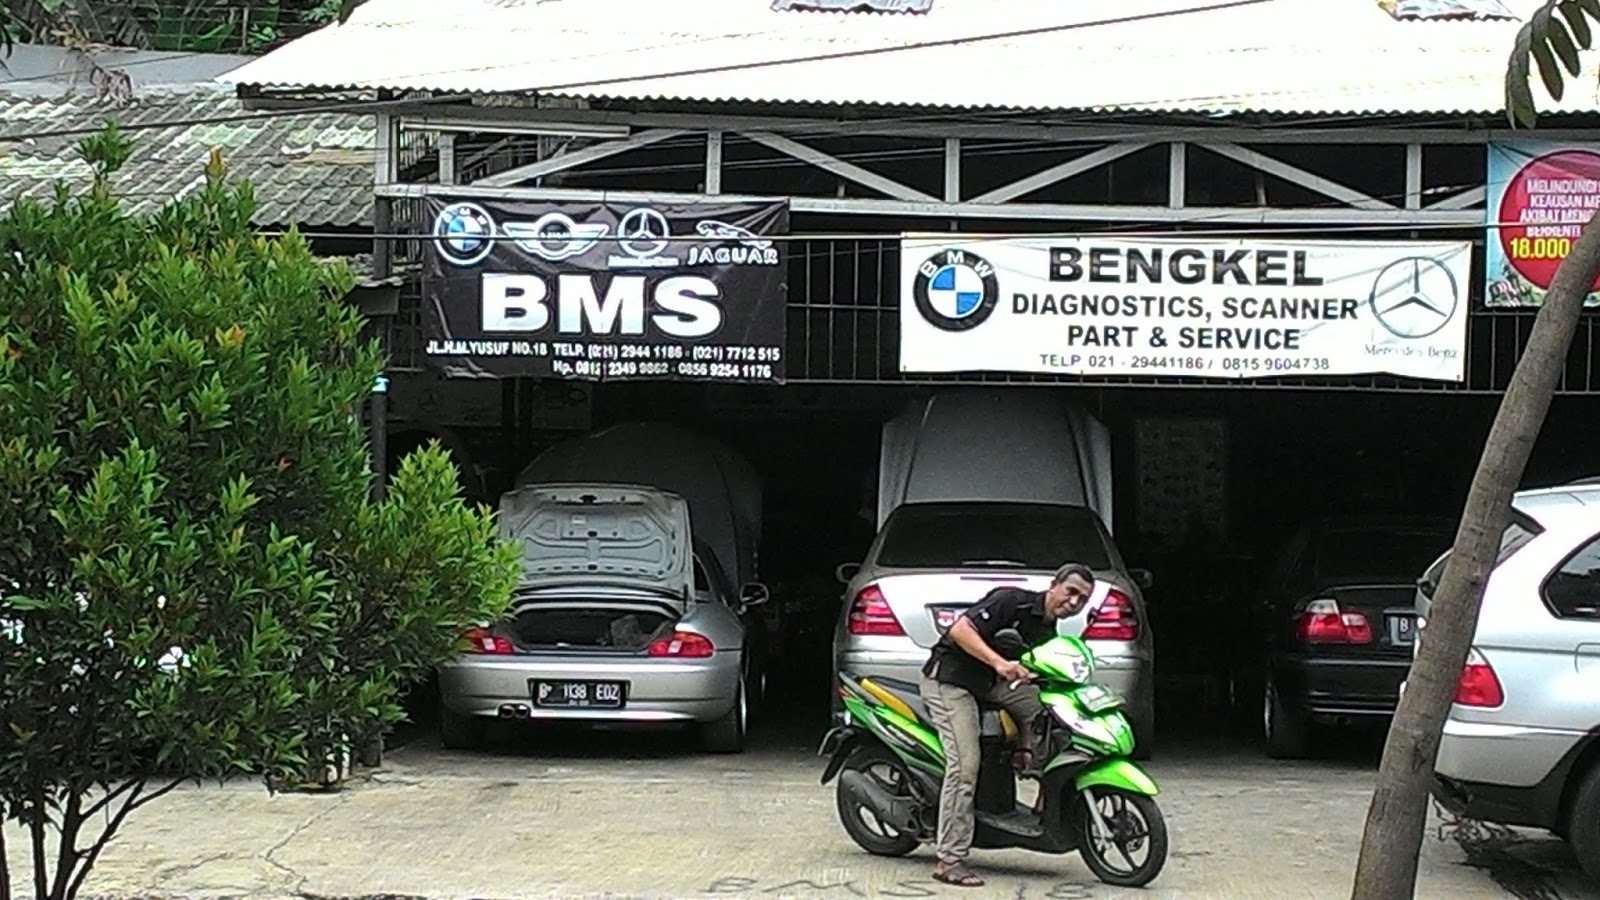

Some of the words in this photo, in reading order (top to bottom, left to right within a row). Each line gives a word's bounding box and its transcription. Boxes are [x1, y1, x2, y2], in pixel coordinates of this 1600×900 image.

[1530, 194, 1582, 208] KEAUSAN
[1520, 208, 1559, 224] AKIBAT
[687, 247, 778, 265] JAGUAR
[920, 250, 993, 278] BMW
[1048, 247, 1324, 286] BENGKEL
[481, 273, 722, 337] BMS
[1012, 293, 1212, 323] DIAGNOSTICS,
[1221, 298, 1358, 320] SCANNER
[1067, 325, 1139, 347] PART
[1149, 327, 1168, 348] &
[1178, 327, 1300, 350] SERVICE
[620, 344, 651, 358] 2944
[693, 345, 723, 361] (021)
[726, 346, 756, 360] 7712
[758, 347, 780, 361] 515
[1040, 354, 1081, 368] TELP
[1089, 355, 1115, 368] 021
[1131, 356, 1204, 369] 29441186
[1222, 357, 1259, 370] 0815
[1264, 357, 1330, 371] 9604738
[742, 365, 772, 378] 1176
[1400, 617, 1409, 633] B
